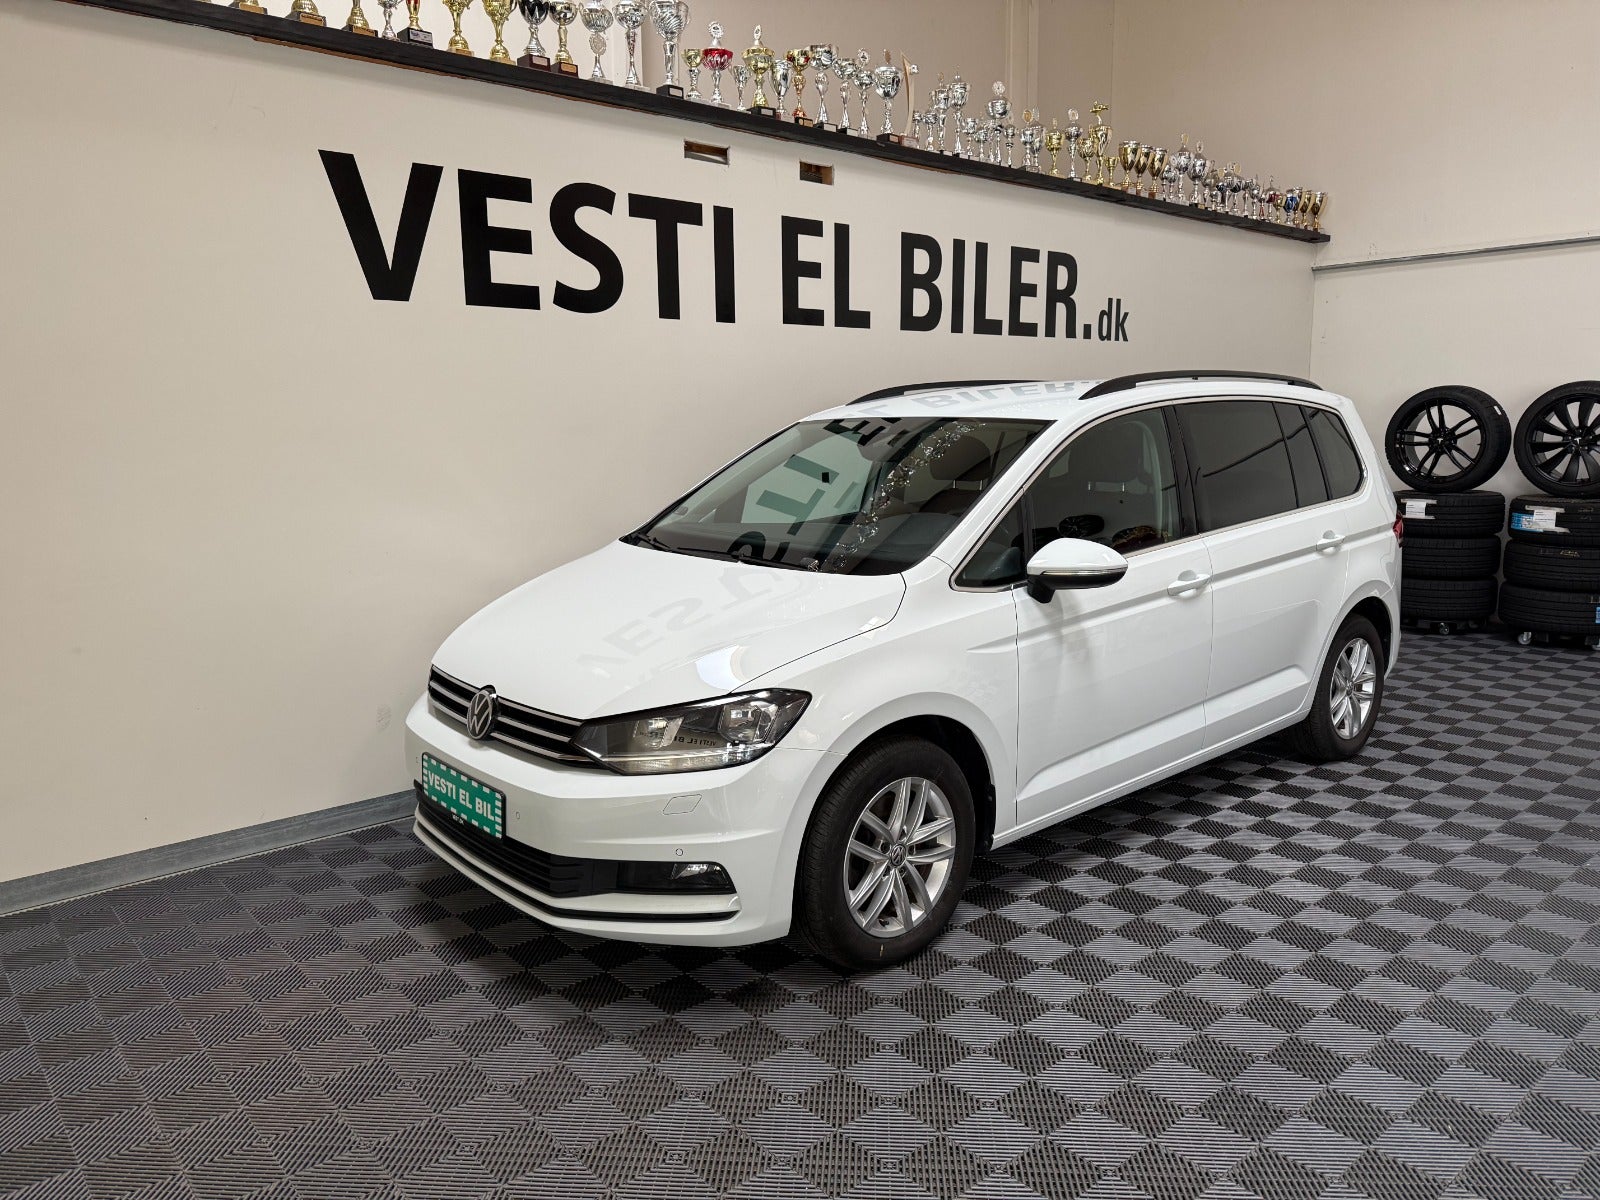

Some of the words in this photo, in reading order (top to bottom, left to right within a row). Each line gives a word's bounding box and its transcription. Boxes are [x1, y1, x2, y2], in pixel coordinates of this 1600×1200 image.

[318, 150, 735, 323] VESTI
[782, 216, 870, 328] EL
[428, 771, 457, 800] VESTI
[459, 788, 473, 809] EL
[475, 797, 495, 821] BIL
